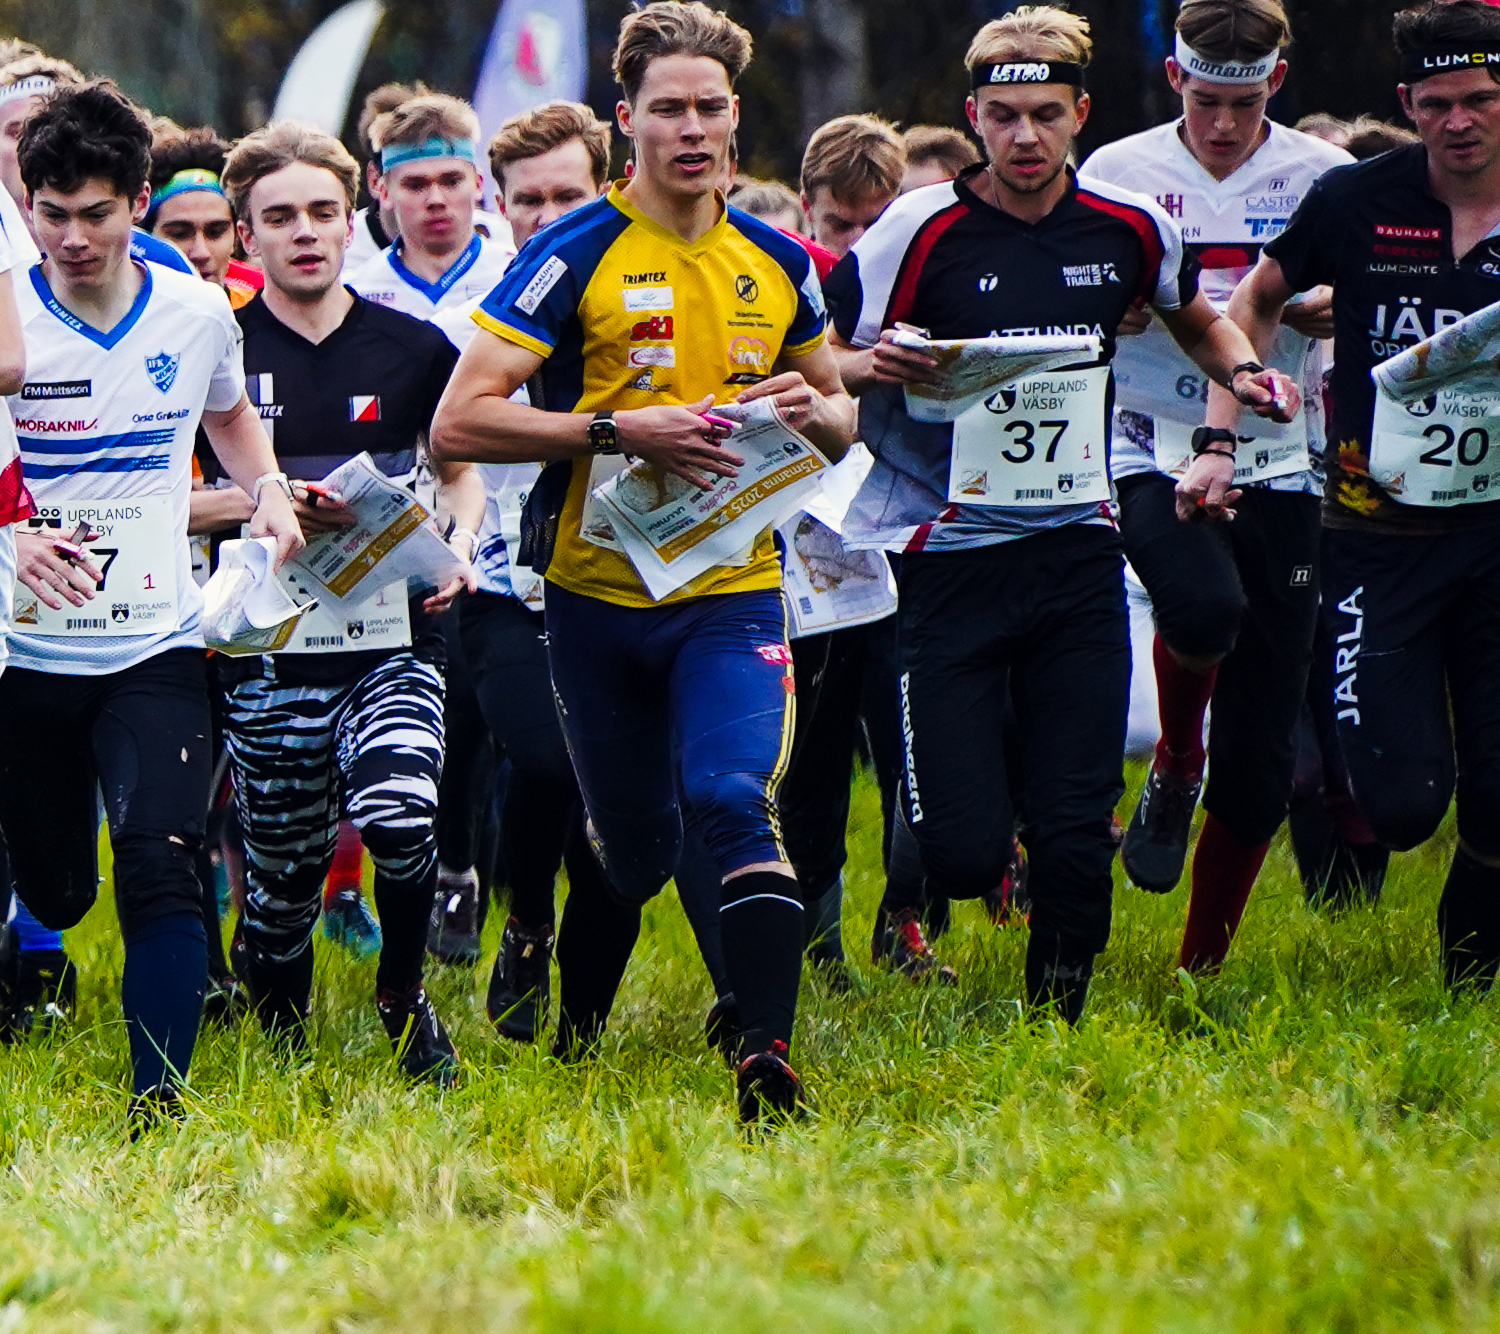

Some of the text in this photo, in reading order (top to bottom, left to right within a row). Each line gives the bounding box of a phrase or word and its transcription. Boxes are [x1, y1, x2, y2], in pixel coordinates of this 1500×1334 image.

[990, 63, 1049, 82] LETRO
[1190, 58, 1266, 77] noname
[1377, 226, 1439, 238] BAUHAUS
[623, 271, 667, 284] TRIMTEX
[1370, 264, 1438, 274] LUMONITE
[48, 299, 83, 330] TRIMTEX
[1023, 379, 1087, 394] UPPLANDS
[1022, 394, 1065, 409] VÄSBY
[1001, 420, 1091, 463] 37 1
[1420, 425, 1489, 467] 20
[731, 459, 819, 514] 25manna 2025
[68, 506, 142, 521] UPPLANDS
[90, 548, 156, 591] 7 1
[1335, 586, 1364, 726] JÄRLA
[900, 671, 923, 823] bagheera
